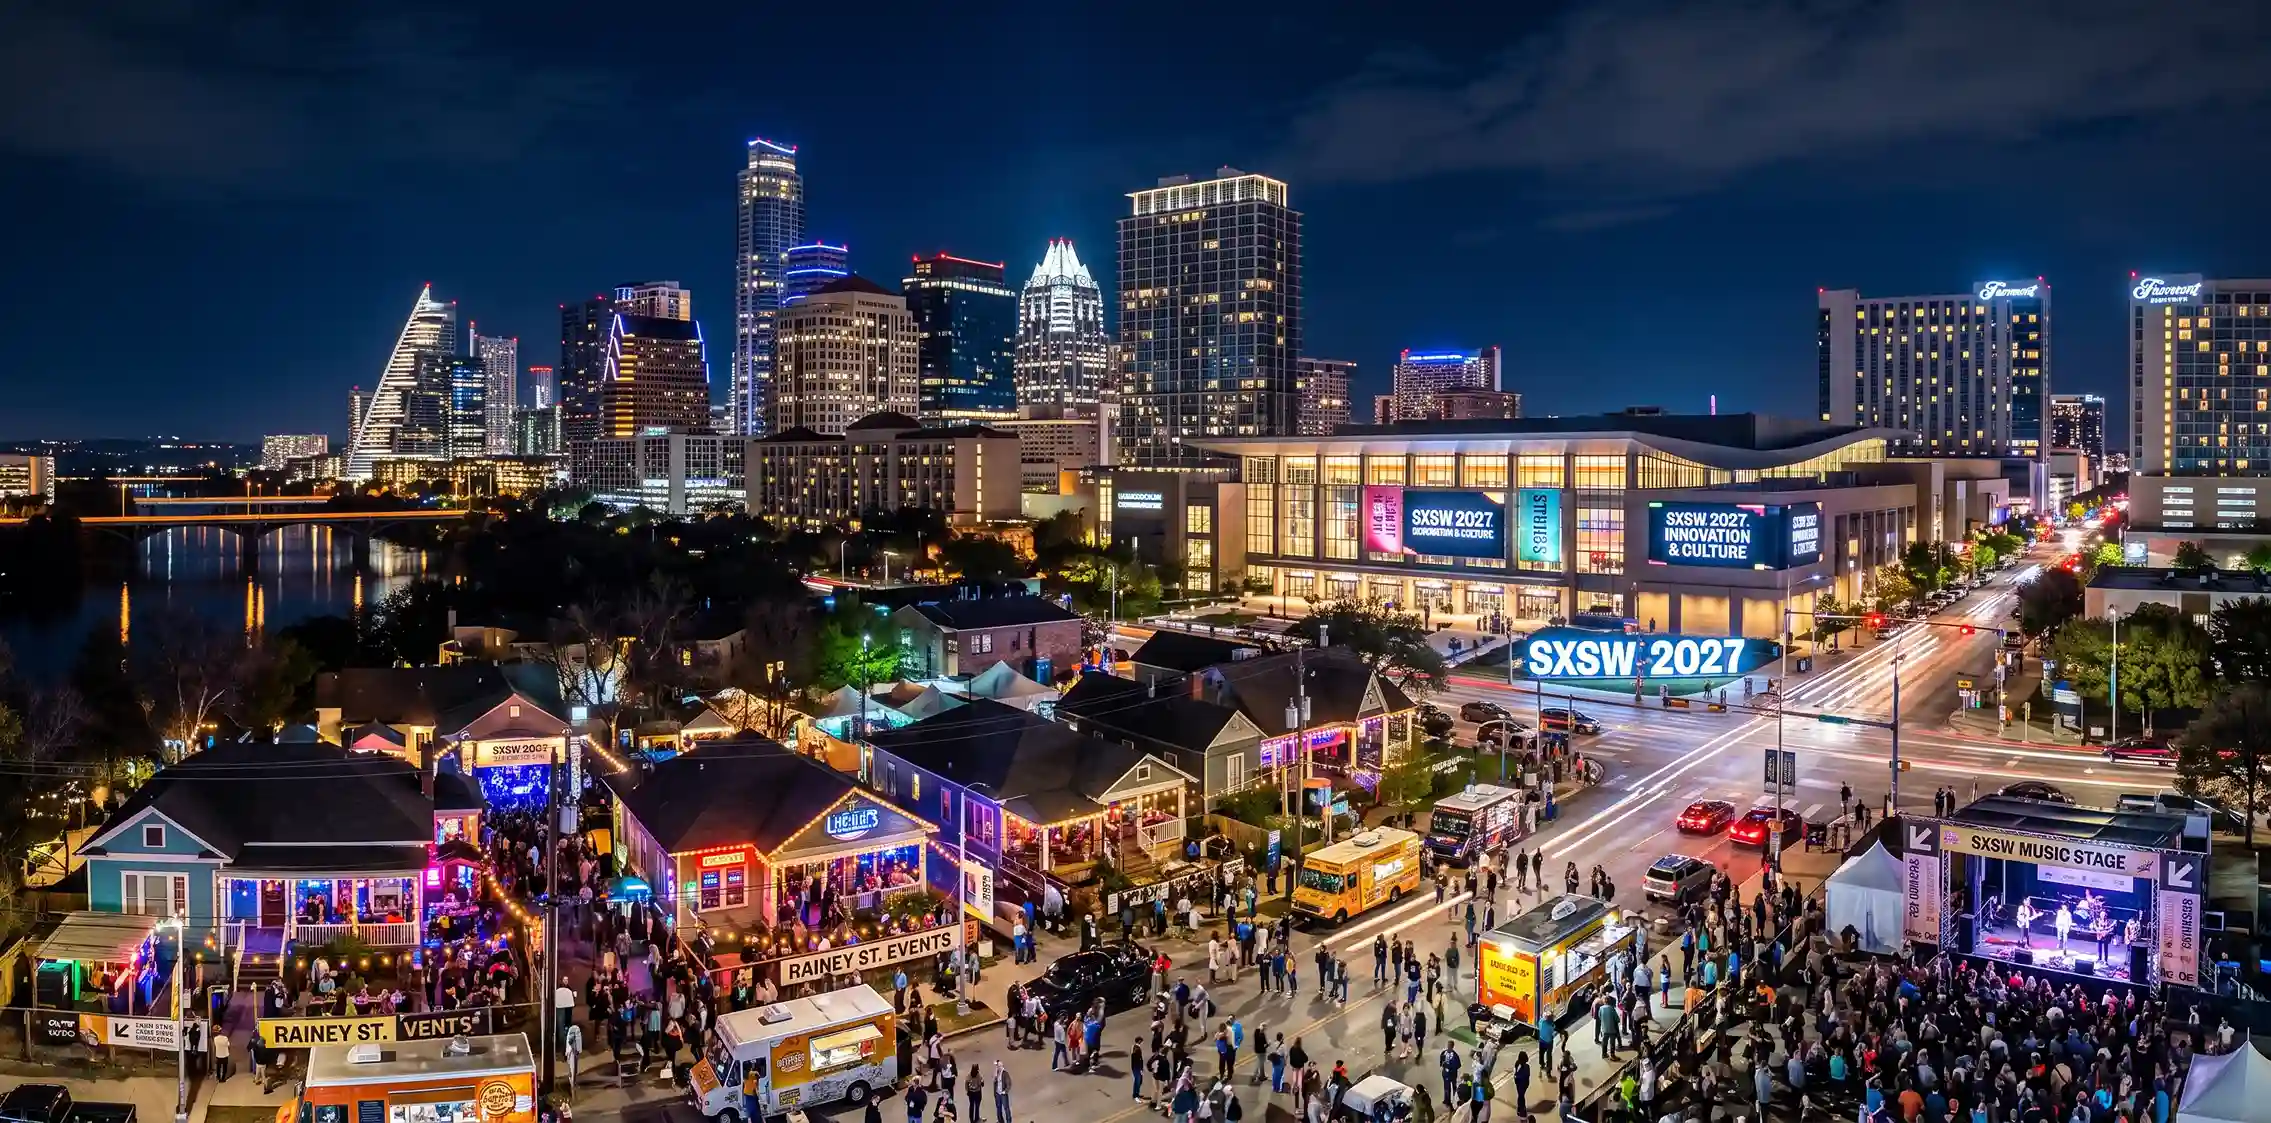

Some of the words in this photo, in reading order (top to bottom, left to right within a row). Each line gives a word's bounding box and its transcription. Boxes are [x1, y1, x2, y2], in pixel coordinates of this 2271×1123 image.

[1664, 527, 1751, 544] INNOVATION
[1668, 542, 1680, 557] &
[1681, 543, 1748, 560] CULTURE
[1528, 639, 1637, 676] SXSW
[1650, 639, 1746, 675] 2027
[492, 745, 520, 755] SXSW
[1971, 834, 2015, 855] SXSW
[2019, 842, 2071, 863] MUSIC
[2073, 848, 2127, 870] STAGE
[789, 951, 855, 980] RAINEY
[858, 947, 882, 966] ST.
[887, 931, 952, 960] EVENTS
[274, 1023, 352, 1044] RAINEY
[357, 1022, 388, 1041] ST.
